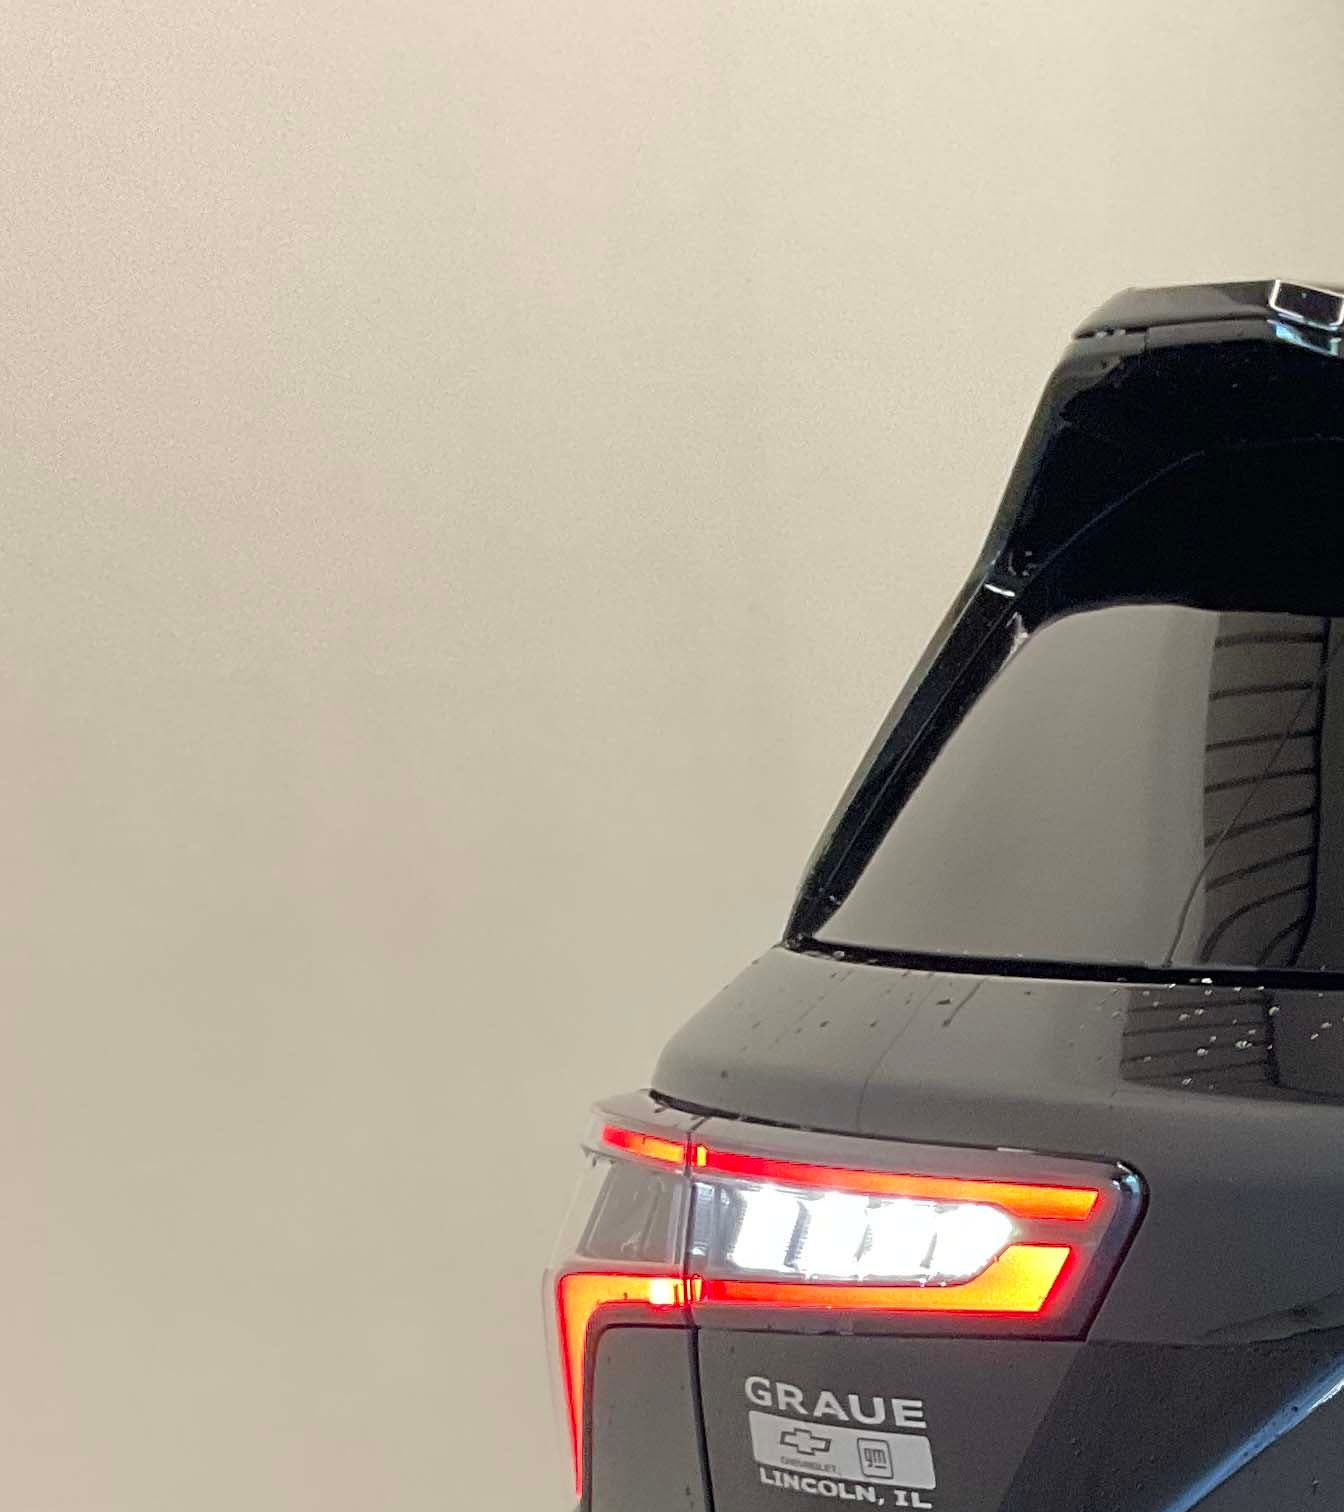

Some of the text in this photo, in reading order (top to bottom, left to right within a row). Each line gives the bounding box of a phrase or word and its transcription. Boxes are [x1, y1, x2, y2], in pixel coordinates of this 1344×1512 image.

[745, 1376, 927, 1428] GRAUE
[760, 1467, 932, 1509] LINCOLN, IL
